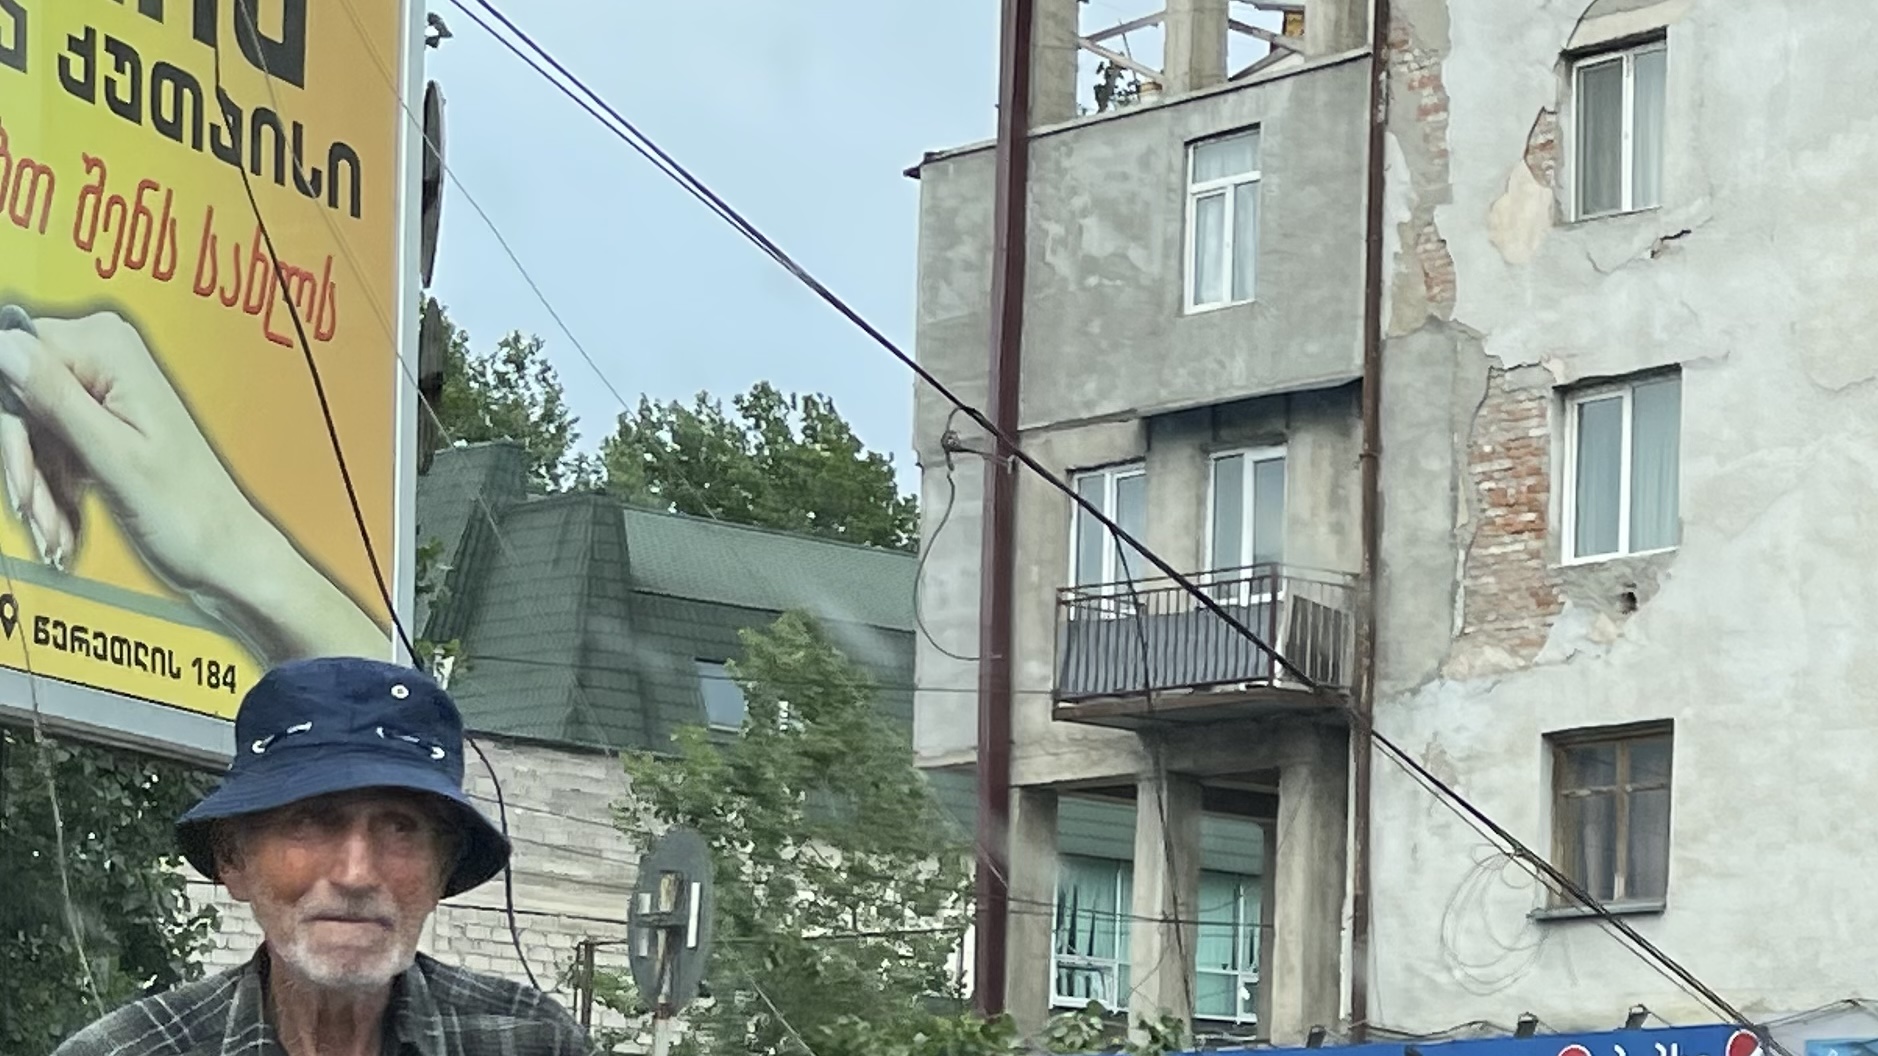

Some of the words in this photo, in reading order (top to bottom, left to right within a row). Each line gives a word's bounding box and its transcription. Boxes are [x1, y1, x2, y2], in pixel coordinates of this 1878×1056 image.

[73, 152, 177, 280] შენს
[193, 204, 336, 348] სახლს
[34, 615, 181, 680] წერეთლის
[192, 657, 236, 694] 184
